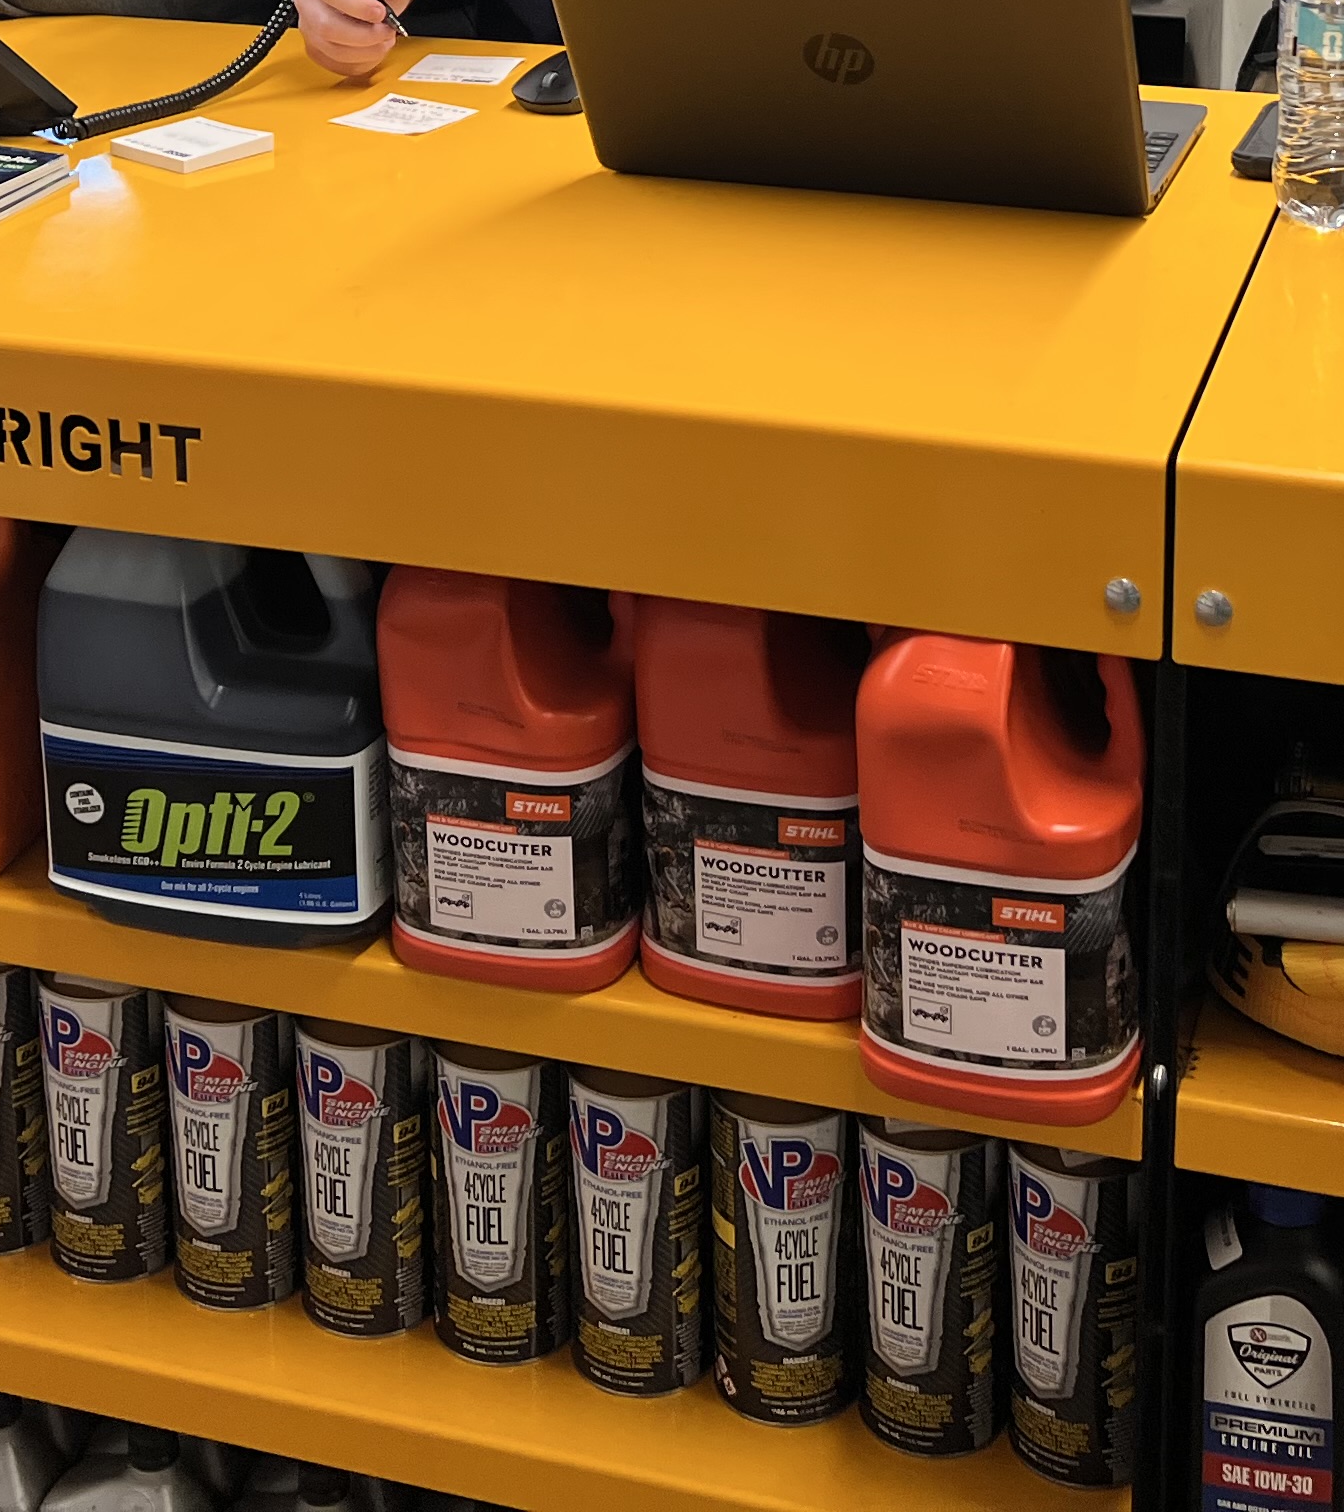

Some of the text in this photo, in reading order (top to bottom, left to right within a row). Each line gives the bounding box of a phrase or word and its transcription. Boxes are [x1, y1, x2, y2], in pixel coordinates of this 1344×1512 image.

[512, 800, 564, 815] STIHL
[121, 788, 301, 867] Opti-2
[432, 830, 553, 857] WOODCUTTER
[785, 825, 839, 839] STIHL
[700, 855, 826, 883] WOODCUTTER
[999, 906, 1058, 924] STIHL
[907, 937, 1043, 969] WOODCUTTER
[440, 1076, 501, 1153] VP
[464, 1170, 507, 1204] 4-CYCLE
[740, 1138, 814, 1211] VP
[465, 1204, 508, 1246] FUEL
[774, 1226, 820, 1261] 4-CYCLE
[776, 1263, 822, 1304] FUEL
[1239, 1343, 1300, 1365] Original
[1213, 1414, 1322, 1444] PREMIUM
[1220, 1433, 1314, 1460] ENGINE OIL
[1222, 1461, 1313, 1496] SAE 10W-30
